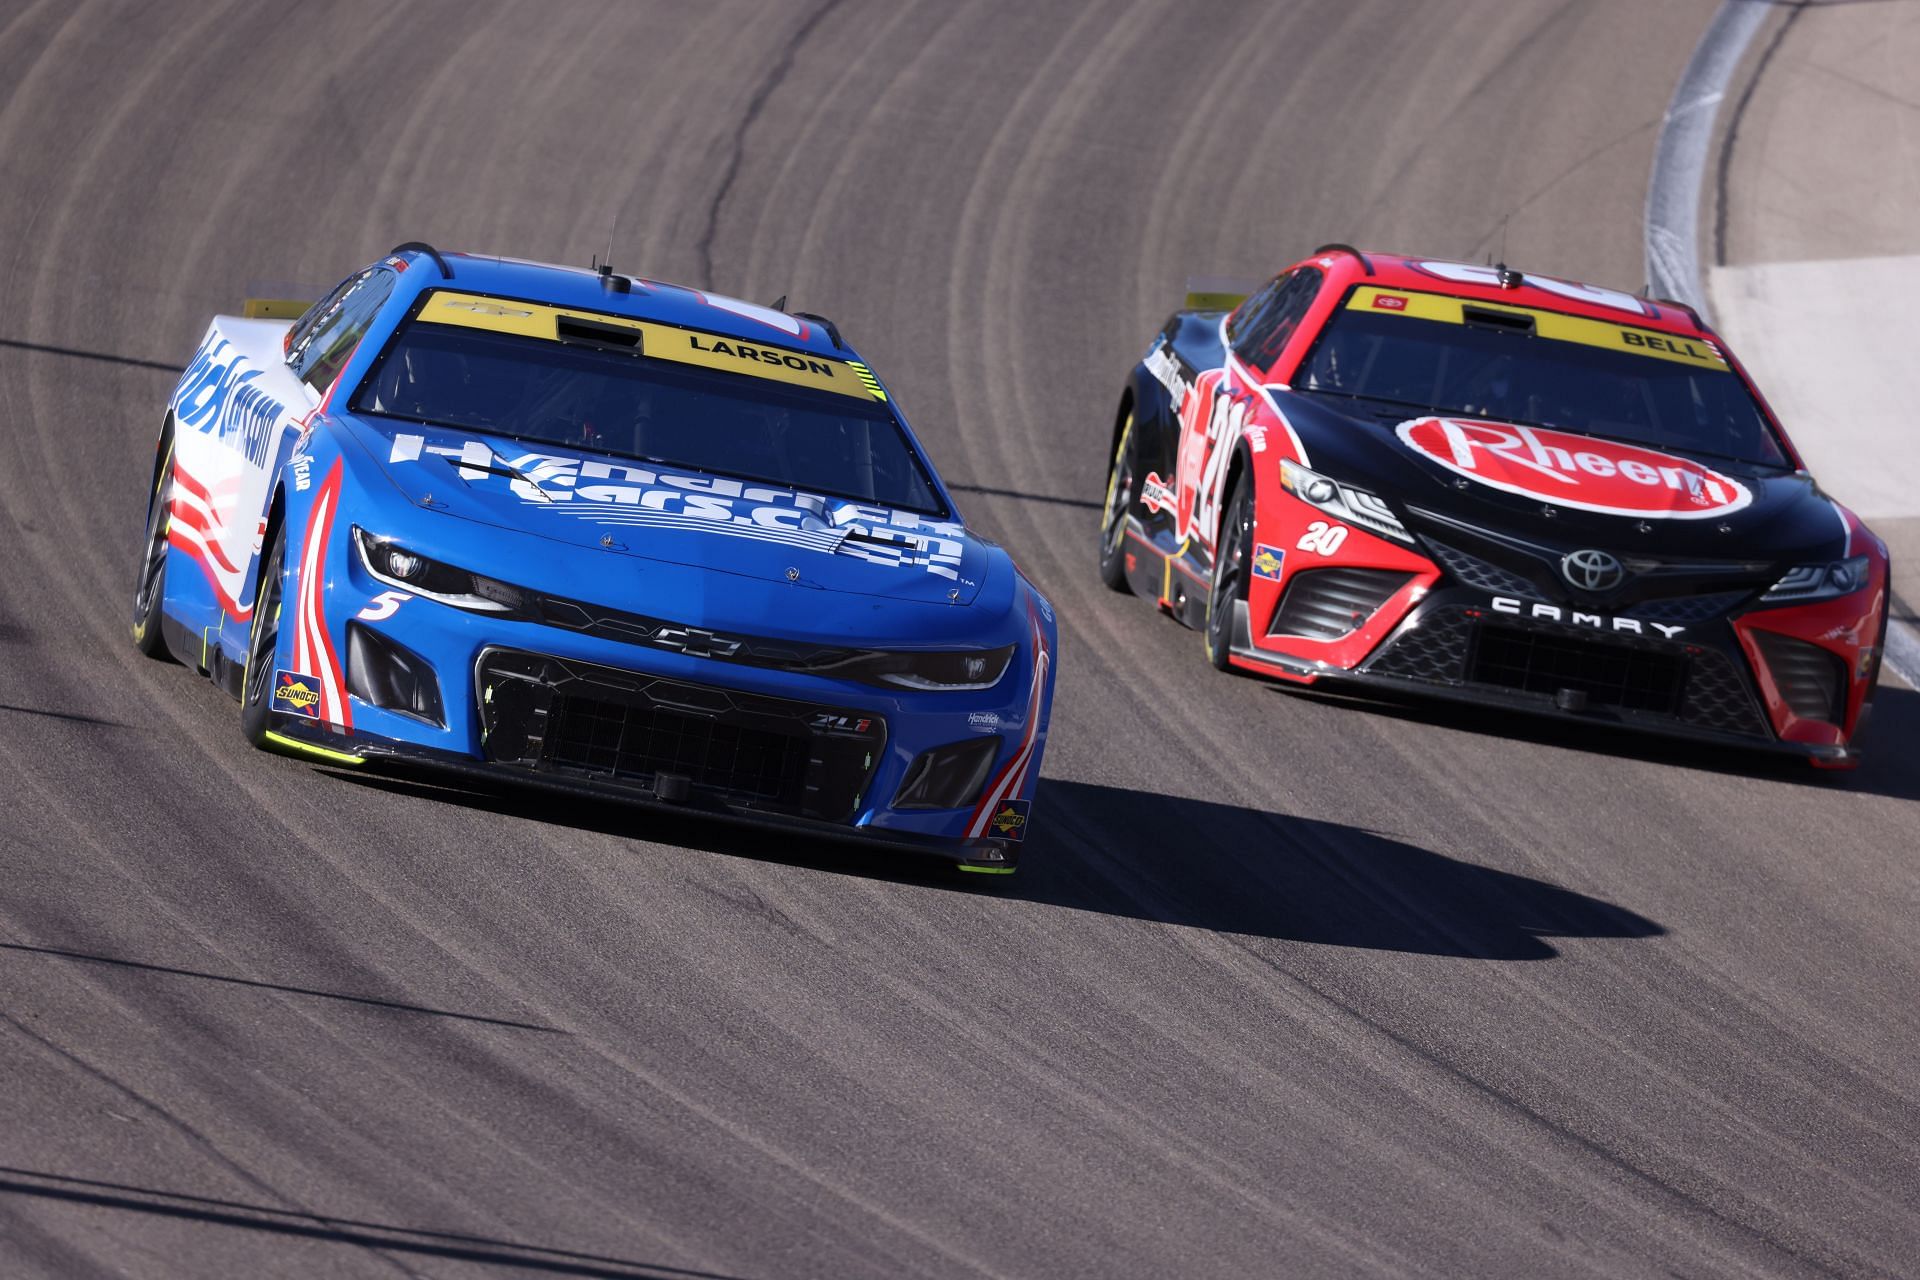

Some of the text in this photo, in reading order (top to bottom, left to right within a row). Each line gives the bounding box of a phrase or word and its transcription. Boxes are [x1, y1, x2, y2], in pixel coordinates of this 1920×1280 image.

[690, 336, 834, 377] LARSON
[1621, 331, 1708, 359] BELL
[1438, 418, 1729, 505] Rheem
[1297, 521, 1349, 556] 20
[357, 591, 413, 621] 5
[1491, 596, 1686, 639] CAMRY
[277, 686, 318, 703] SUNOCO
[968, 712, 999, 725] Hendrick
